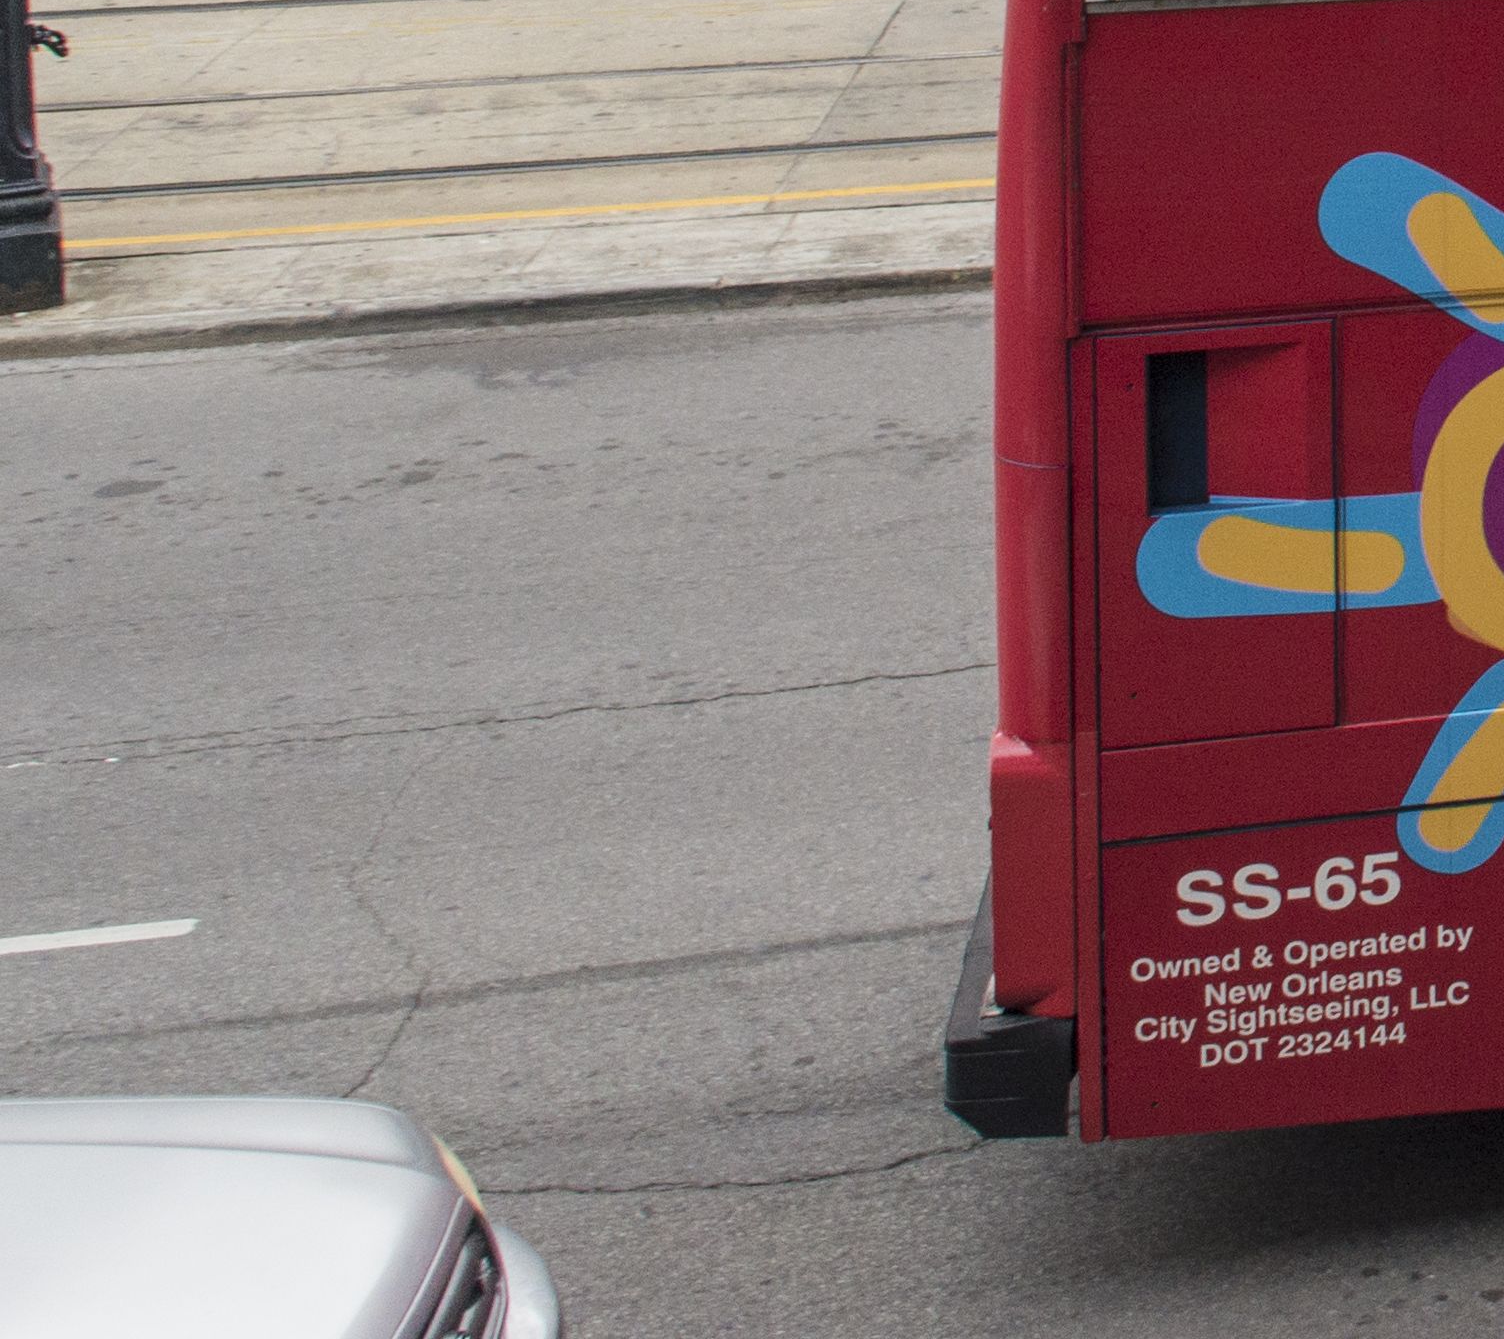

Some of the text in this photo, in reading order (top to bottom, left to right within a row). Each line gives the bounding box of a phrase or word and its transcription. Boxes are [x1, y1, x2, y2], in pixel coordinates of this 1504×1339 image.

[1176, 851, 1401, 926] SS-65
[1130, 924, 1474, 983] Owned & Operated by
[1134, 980, 1471, 1044] City Sightseeing, LLC
[1204, 964, 1403, 1008] New Orleans
[1199, 1022, 1407, 1068] DOT 2324144
